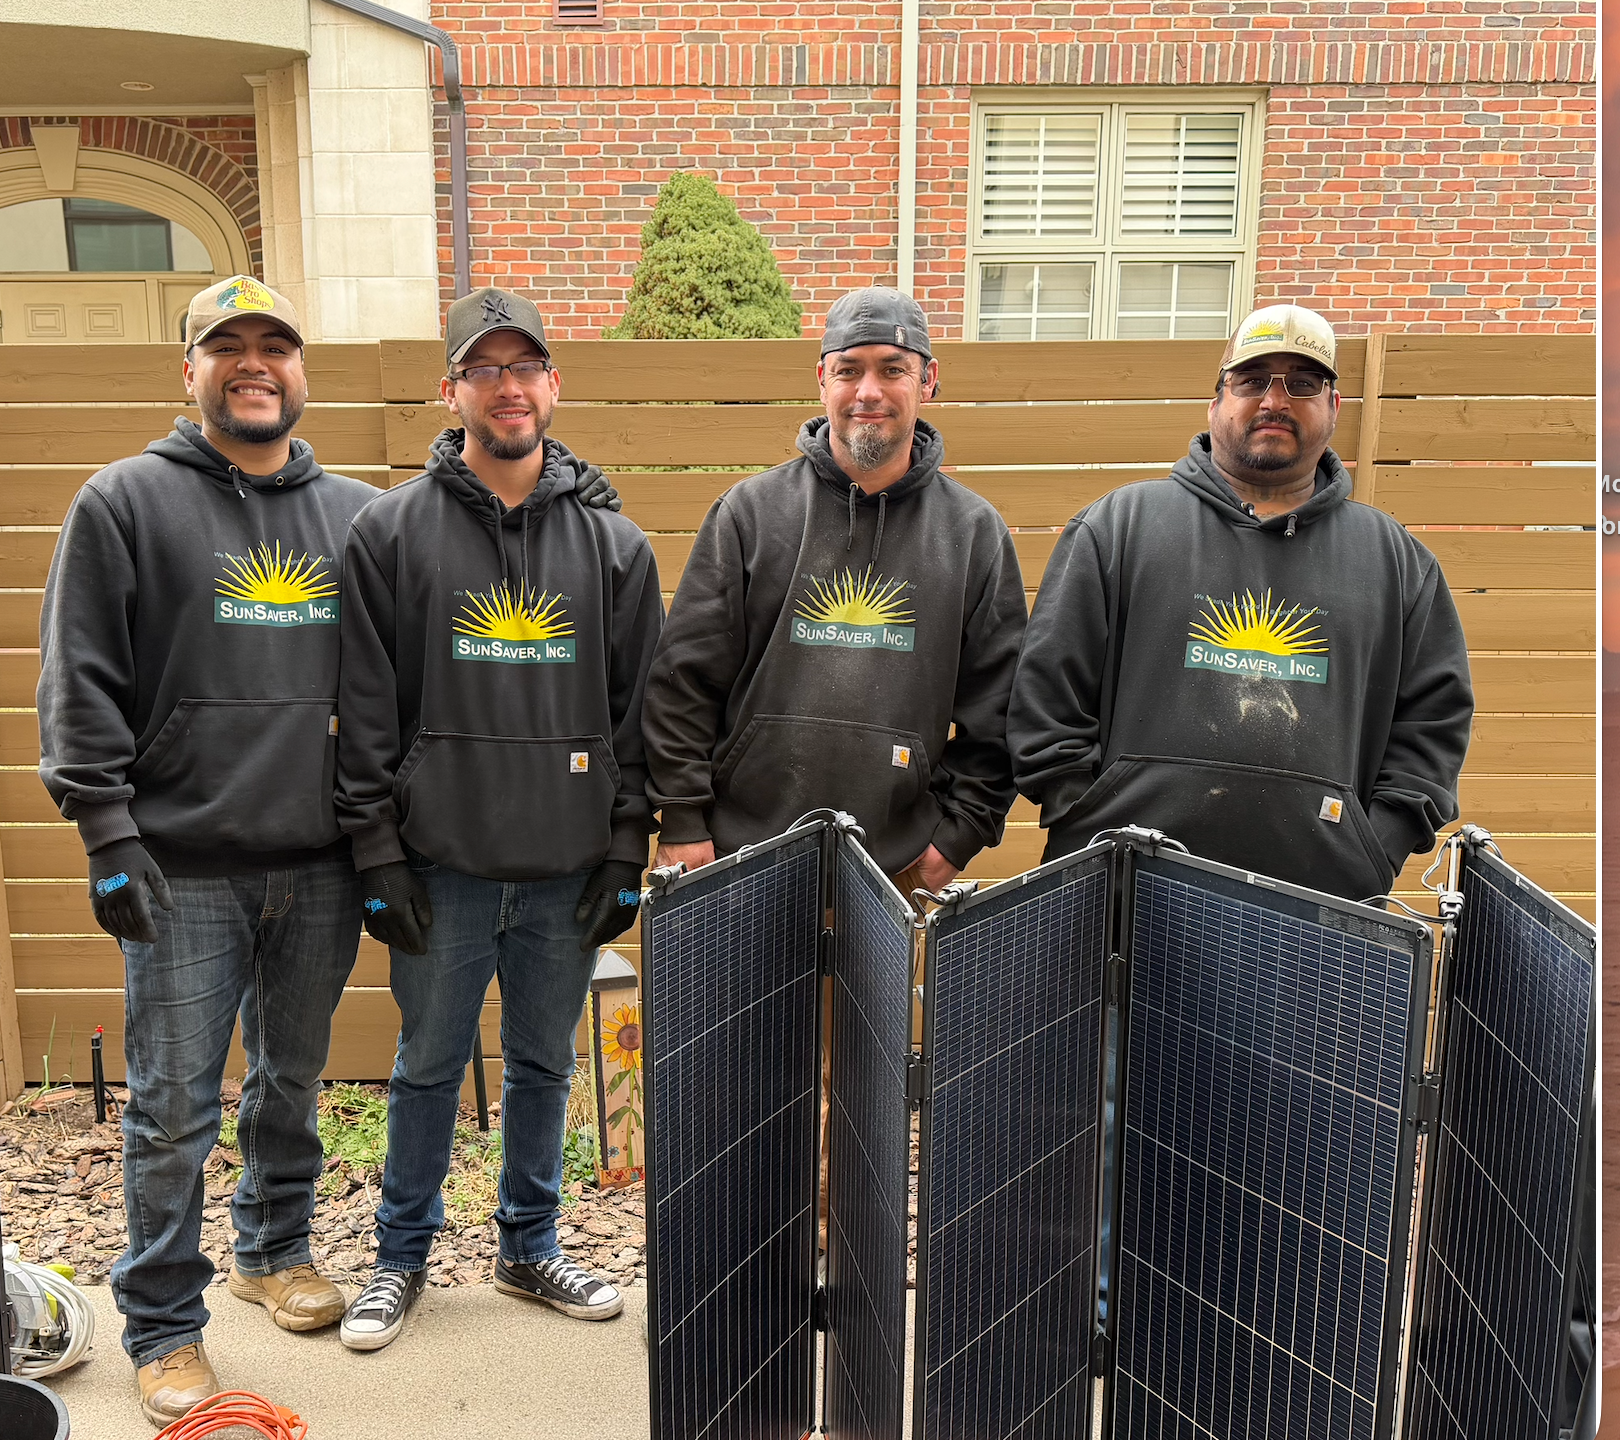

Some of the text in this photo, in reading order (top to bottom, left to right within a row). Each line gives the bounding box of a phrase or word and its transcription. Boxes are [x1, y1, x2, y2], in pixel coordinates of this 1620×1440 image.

[242, 288, 260, 298] Pro
[243, 296, 272, 308] Shops
[480, 294, 512, 322] NY
[1294, 334, 1332, 360] Cabela's
[1314, 608, 1329, 616] Day
